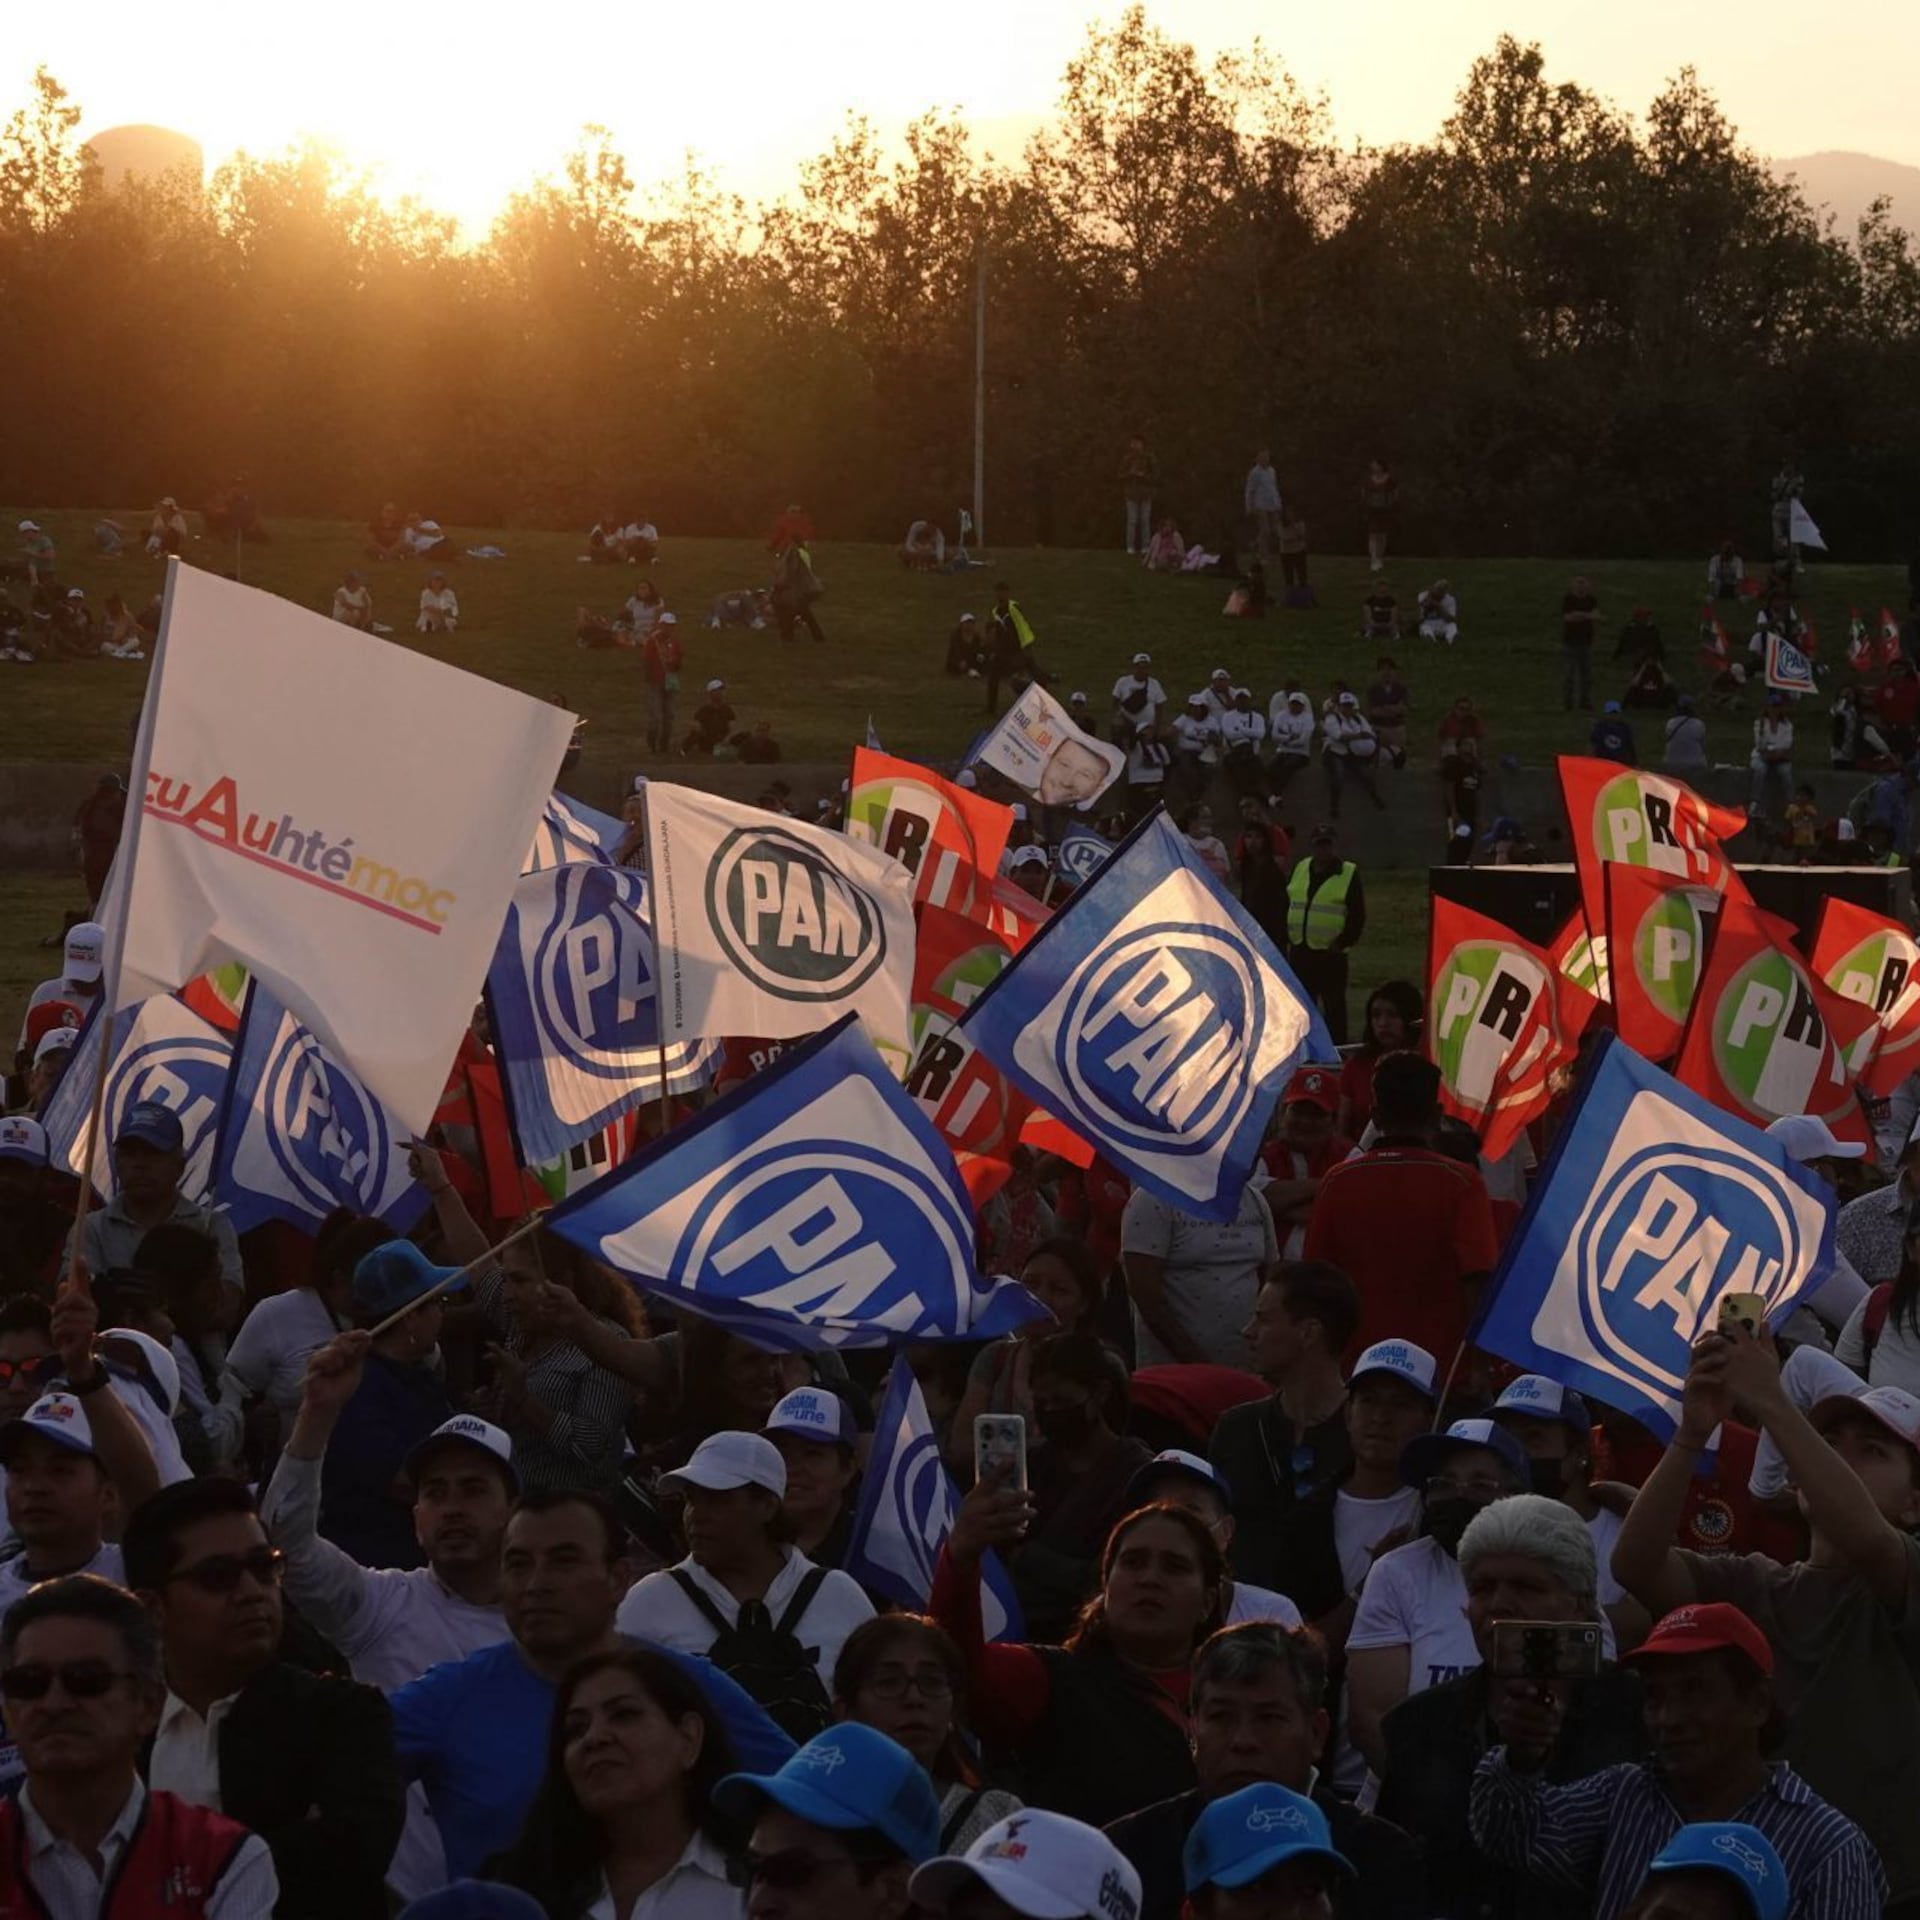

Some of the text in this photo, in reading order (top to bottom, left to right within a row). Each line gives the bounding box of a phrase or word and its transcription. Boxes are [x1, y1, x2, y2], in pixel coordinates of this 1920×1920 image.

[739, 858, 863, 958] PAN
[566, 901, 658, 1040] PA
[1439, 970, 1549, 1082] PRI
[1081, 946, 1245, 1134] PAN
[794, 1409, 825, 1424] une
